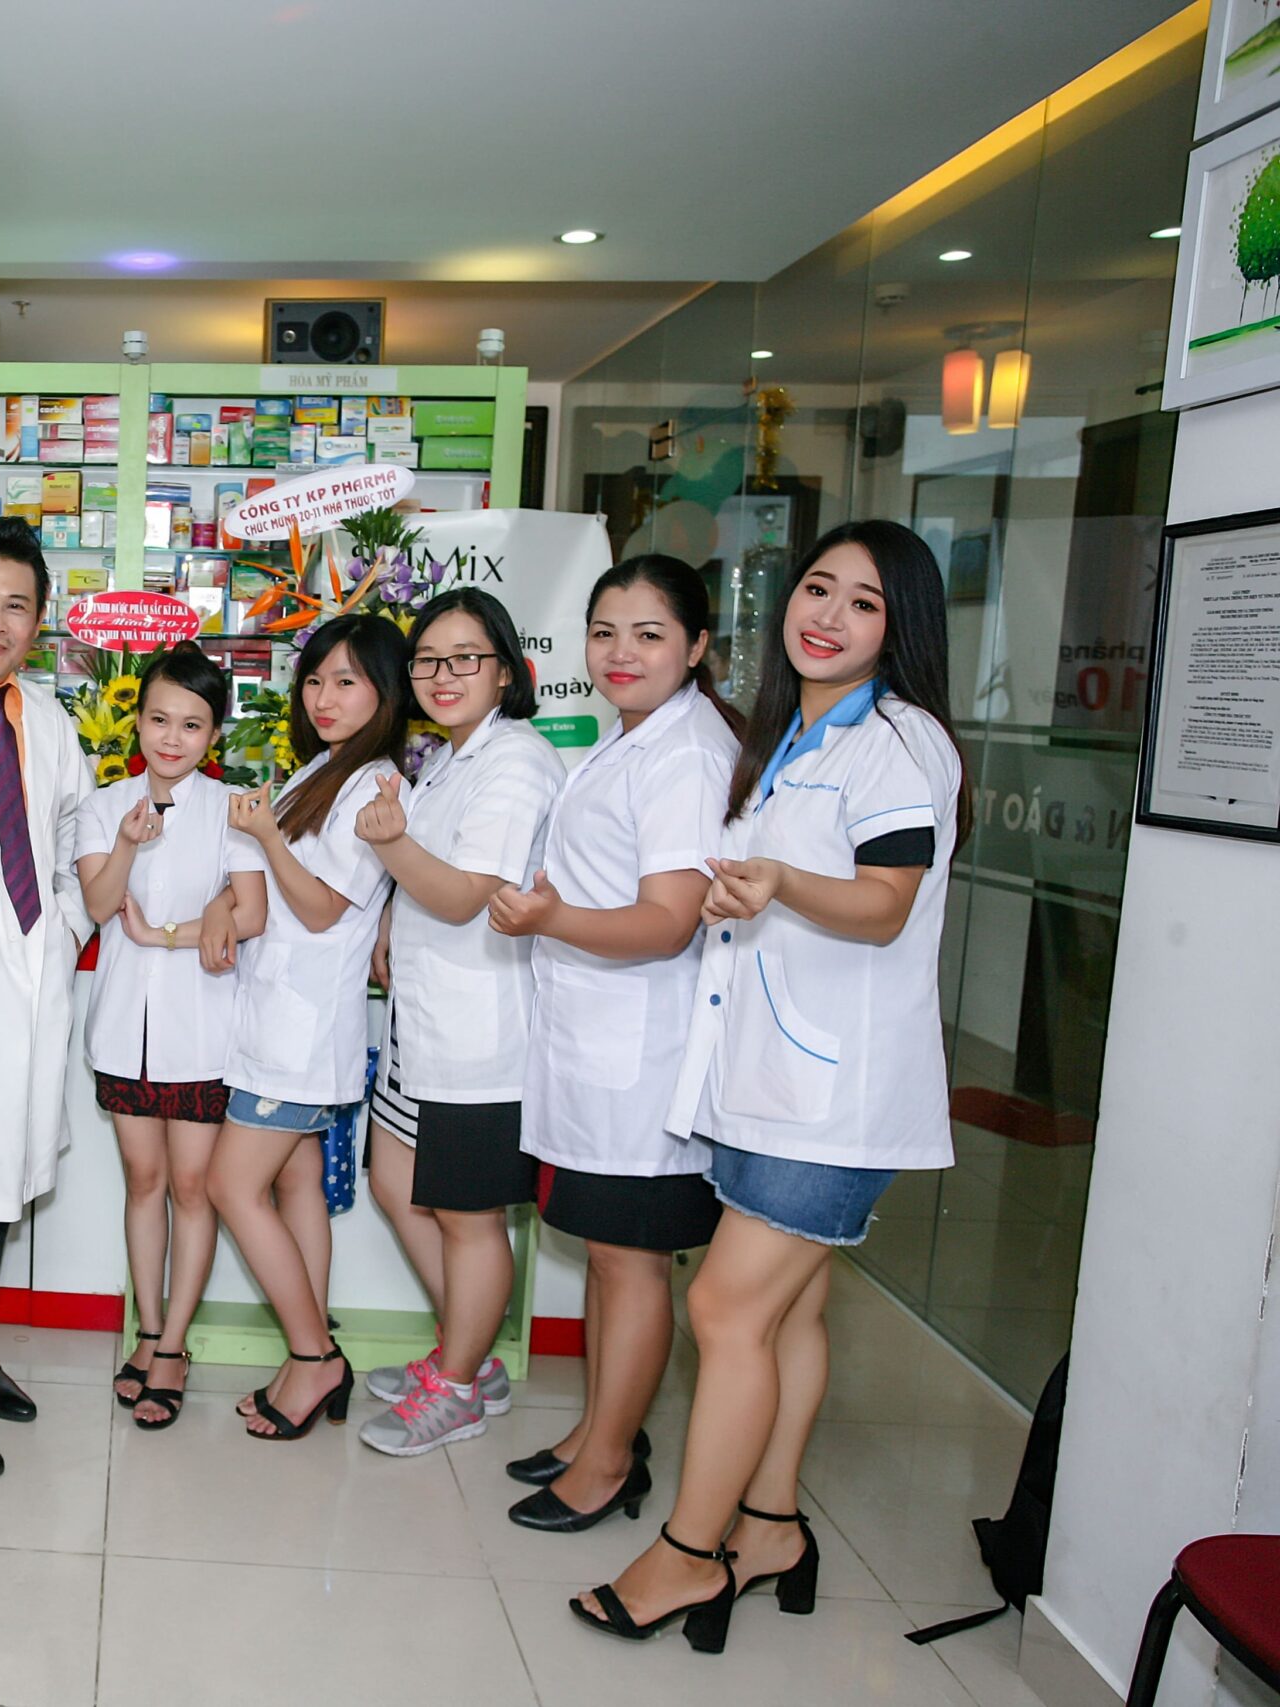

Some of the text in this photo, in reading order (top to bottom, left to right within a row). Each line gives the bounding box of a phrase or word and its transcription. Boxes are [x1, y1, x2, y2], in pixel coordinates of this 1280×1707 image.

[239, 469, 398, 521] CÔNG TY KP PHARMA
[300, 508, 321, 523] 20-11
[158, 620, 198, 629] 20-11
[78, 628, 187, 642] CTY TNHH NHÀ THUỐC TỐT
[540, 675, 594, 698] ngày
[552, 723, 576, 731] Extra
